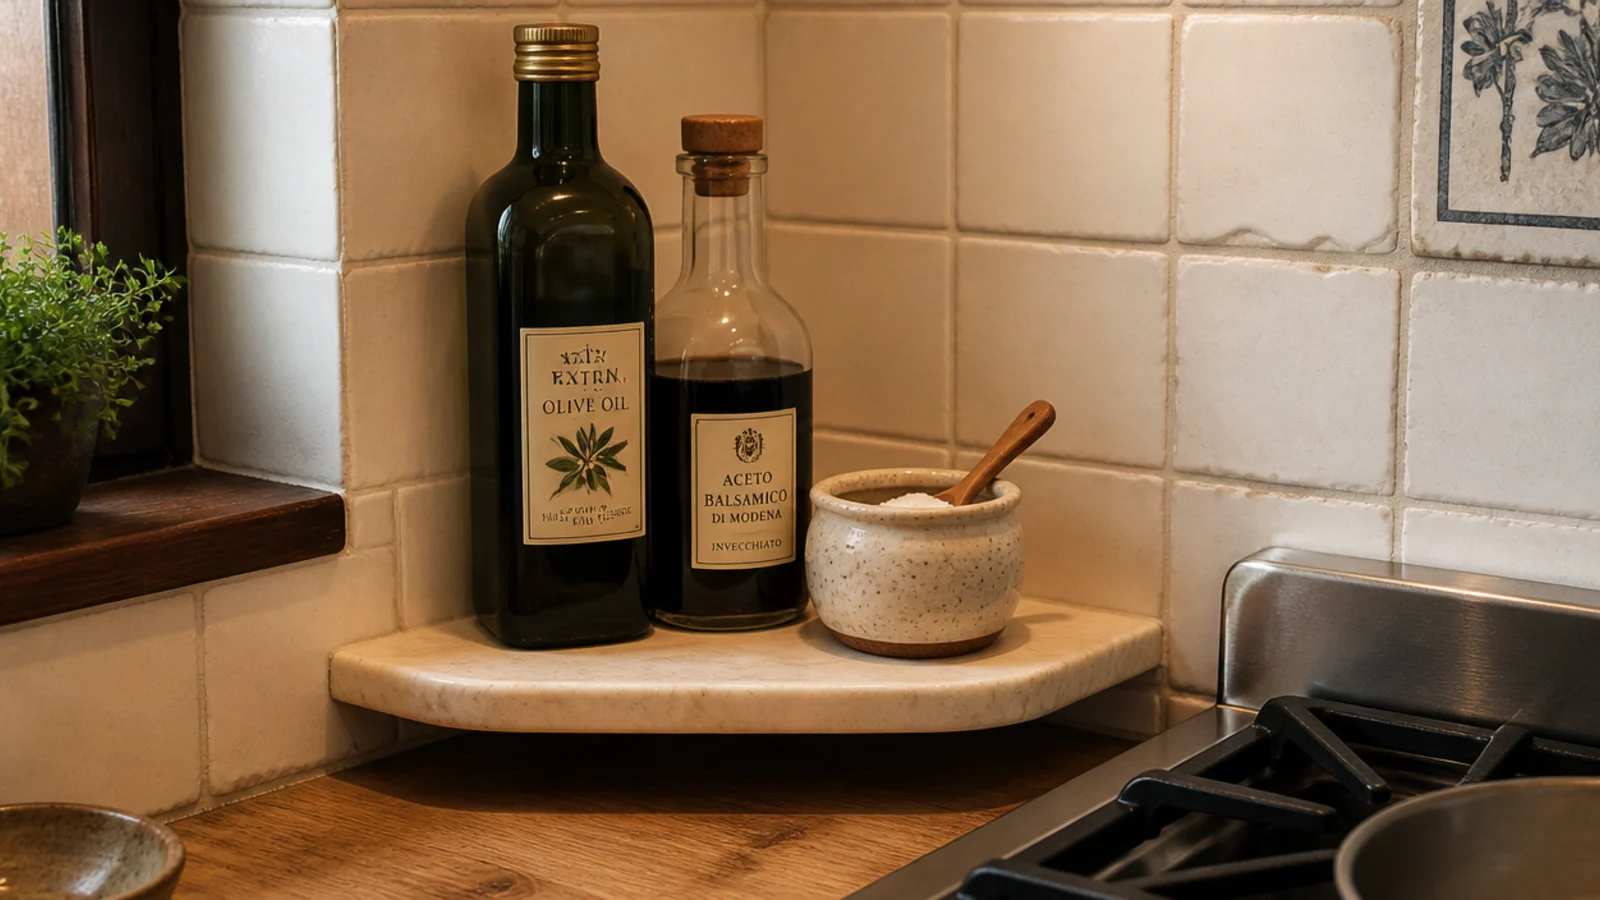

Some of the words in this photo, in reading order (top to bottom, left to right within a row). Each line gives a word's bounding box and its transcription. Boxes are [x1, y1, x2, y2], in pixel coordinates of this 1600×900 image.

[542, 398, 595, 415] OLIVE
[601, 396, 630, 412] OIL
[722, 471, 773, 487] ACETO
[704, 489, 788, 507] BALSAMICO
[712, 513, 725, 524] DI
[729, 509, 783, 524] MODENA
[711, 538, 782, 552] INVECCHIATO
